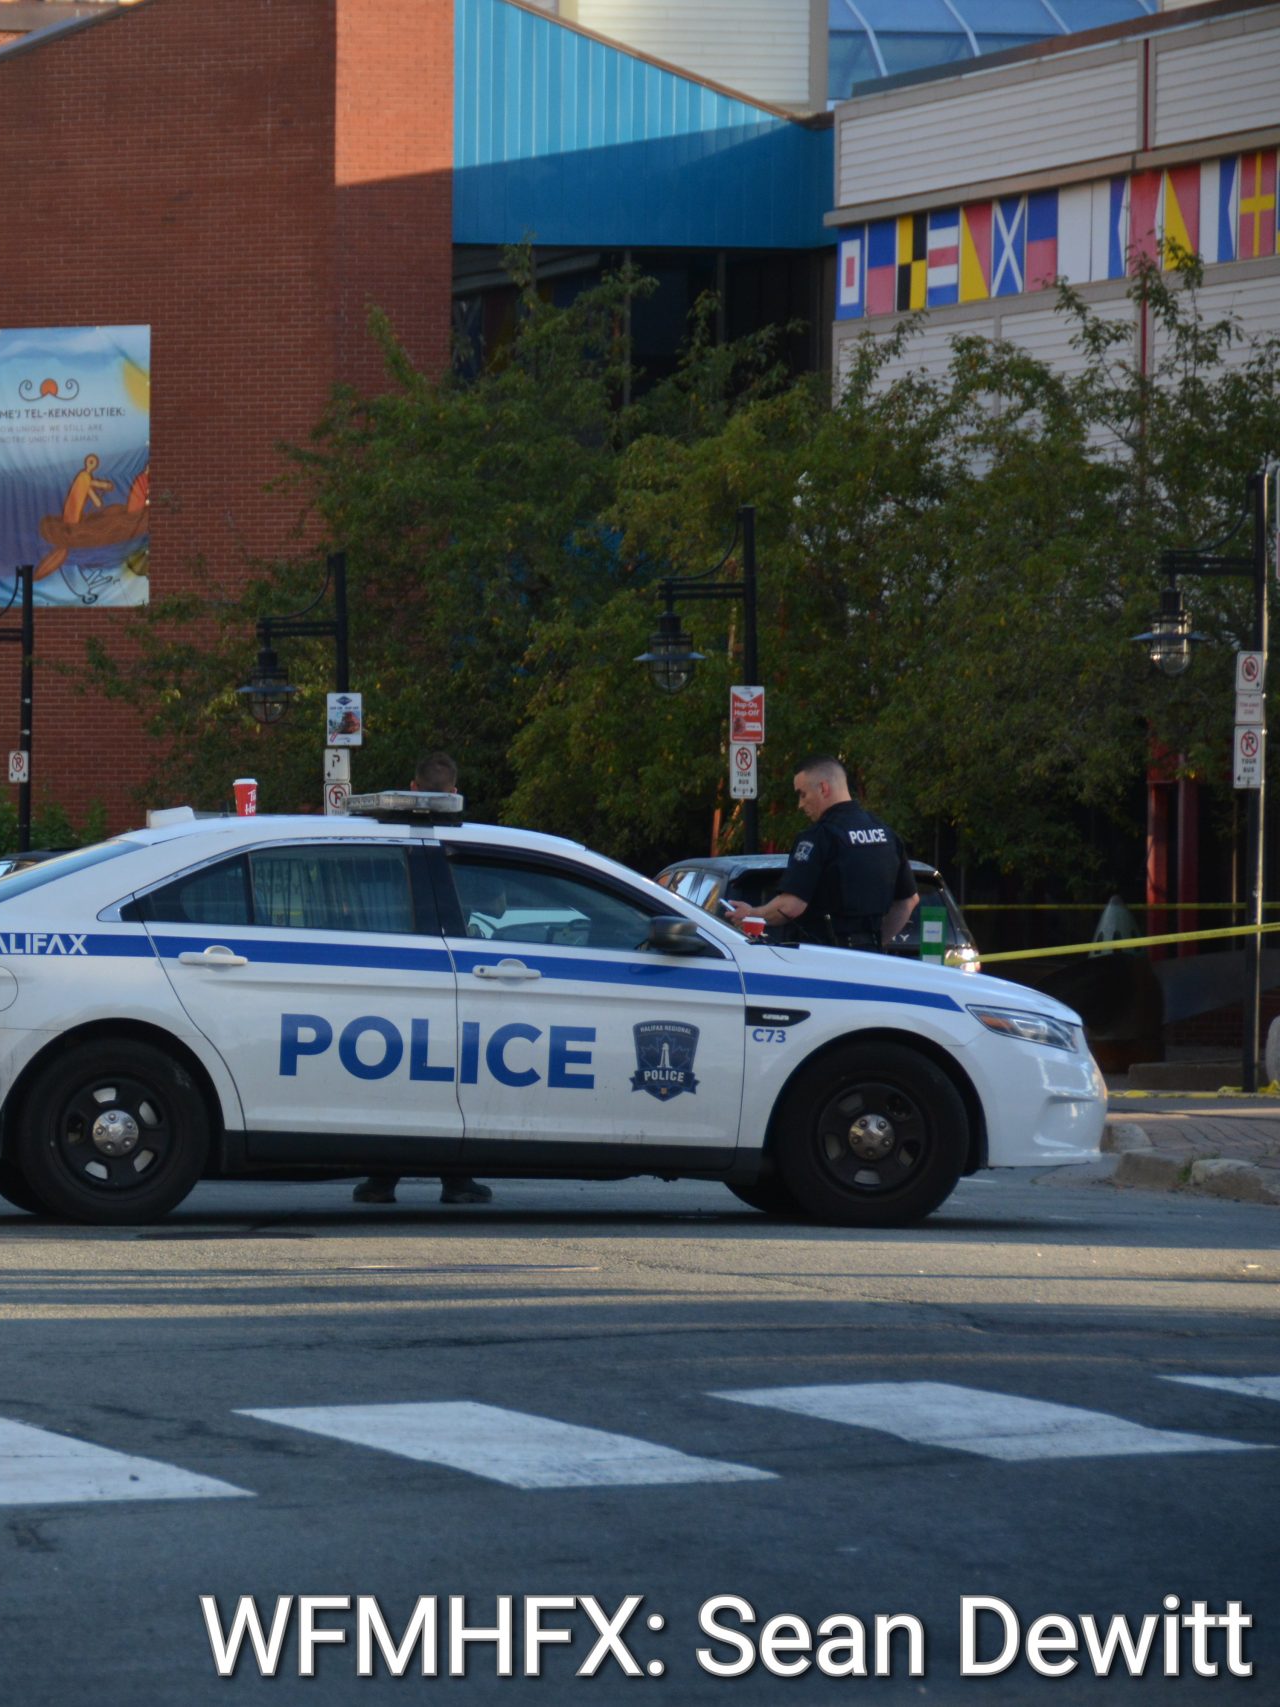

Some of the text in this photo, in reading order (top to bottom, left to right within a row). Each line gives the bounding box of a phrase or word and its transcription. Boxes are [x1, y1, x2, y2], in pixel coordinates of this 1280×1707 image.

[848, 828, 888, 845] POLICE
[640, 1024, 691, 1034] HALIFAX REGIONAL
[752, 1028, 786, 1043] C73
[278, 1013, 597, 1089] POLICE
[643, 1069, 685, 1082] POLICE
